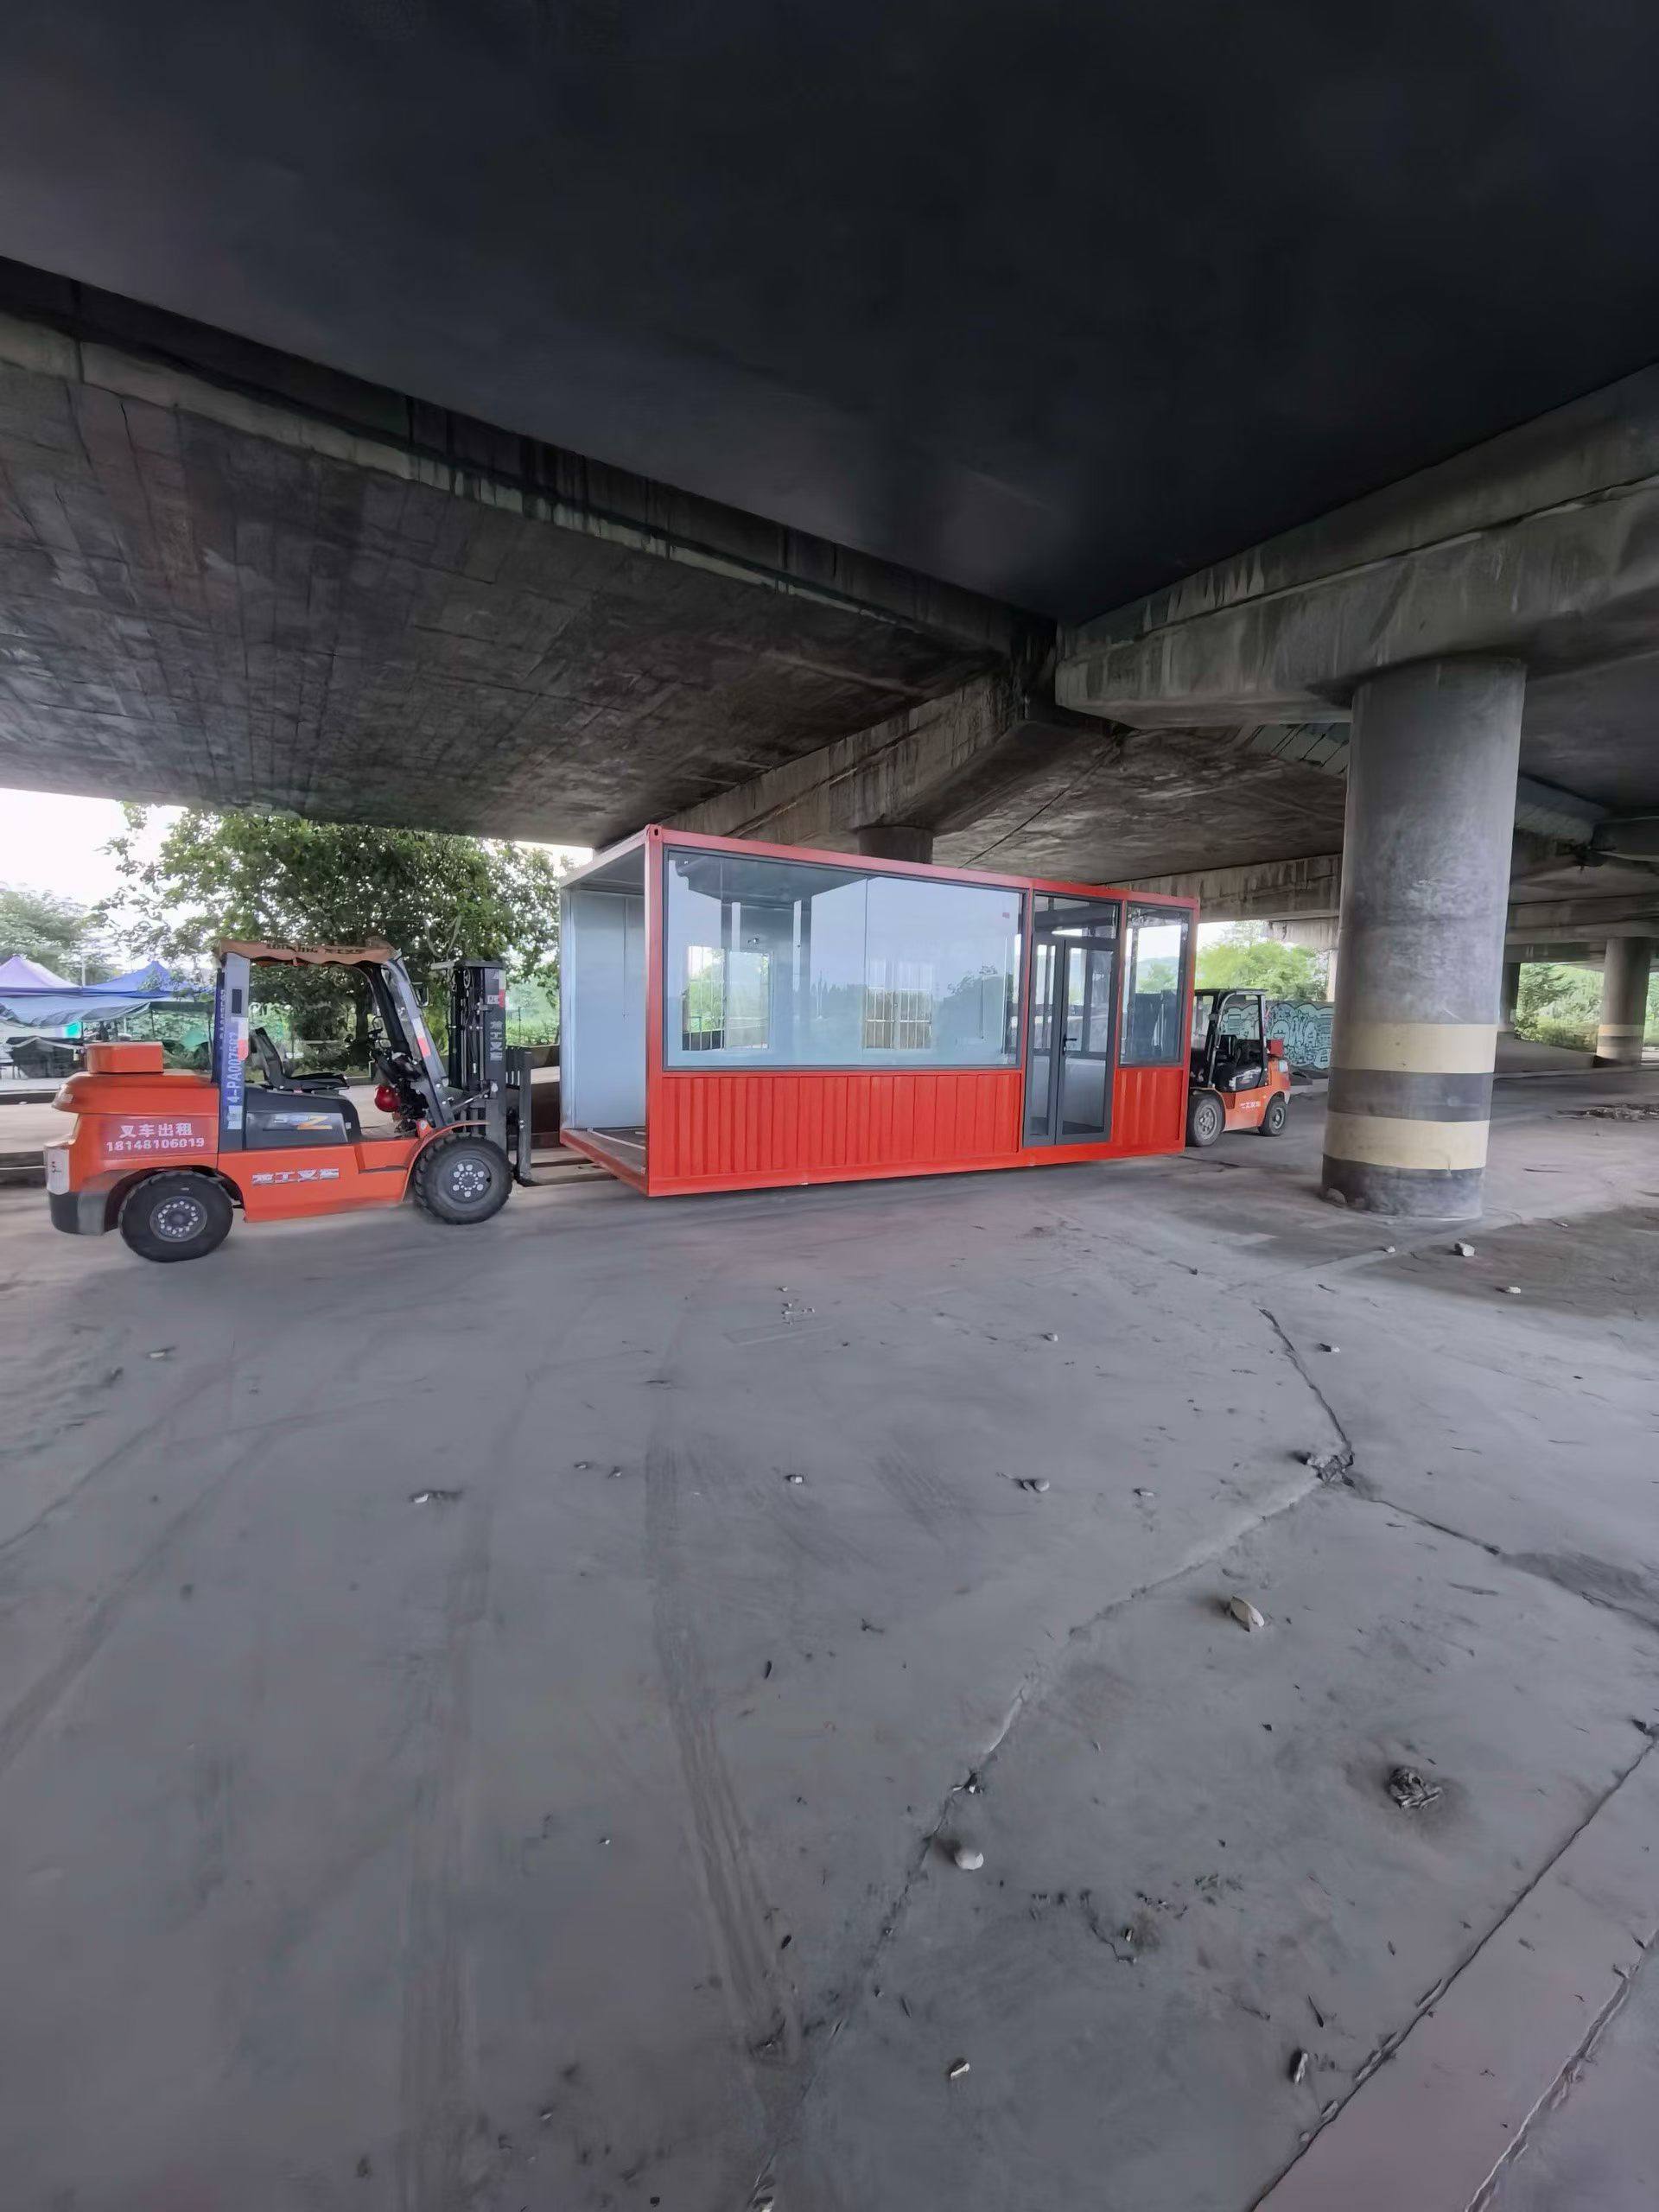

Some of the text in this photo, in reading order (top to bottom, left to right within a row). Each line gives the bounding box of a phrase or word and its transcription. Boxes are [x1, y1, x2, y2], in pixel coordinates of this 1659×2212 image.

[119, 1122, 193, 1138] 叉车出租
[106, 1137, 205, 1152] 18148106019
